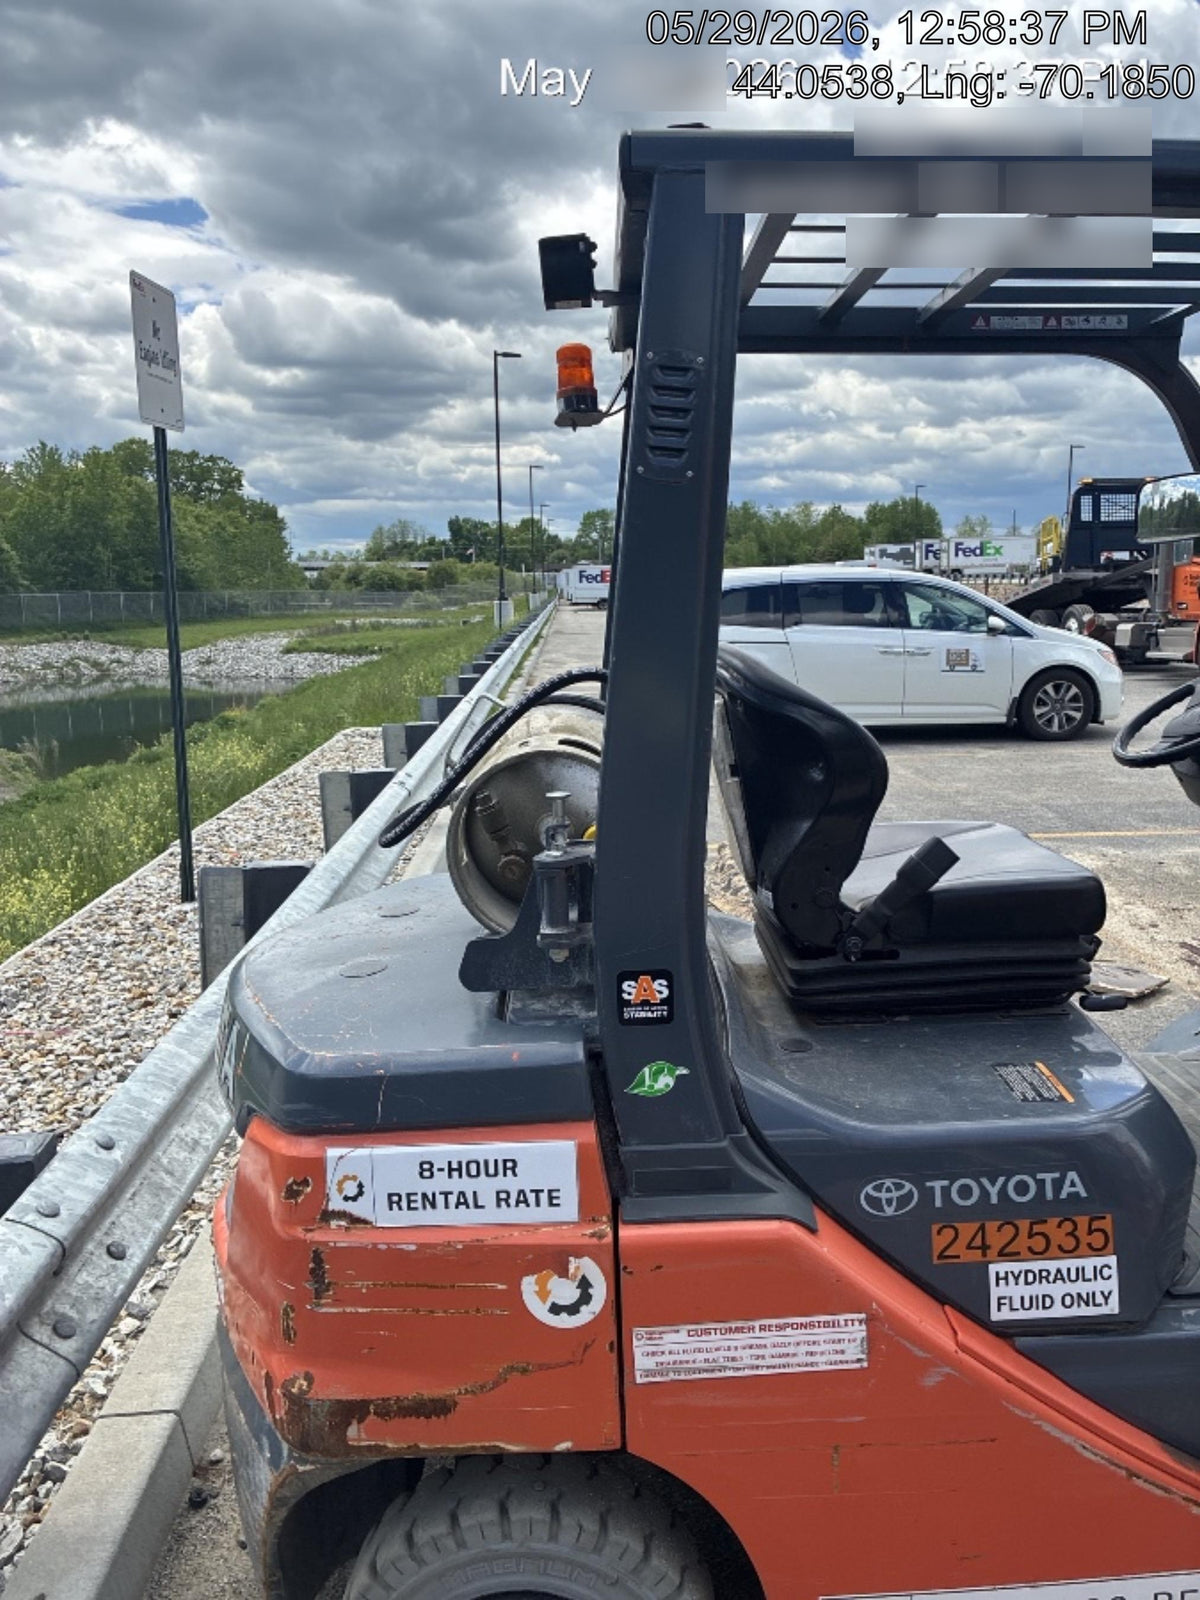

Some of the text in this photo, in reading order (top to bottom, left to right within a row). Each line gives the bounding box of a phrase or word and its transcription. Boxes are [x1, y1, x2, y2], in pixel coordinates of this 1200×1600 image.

[954, 540, 1004, 557] FedEx
[578, 569, 612, 584] FedE
[622, 976, 669, 1003] SAS
[418, 1158, 518, 1180] 8-HOUR
[387, 1188, 561, 1212] RENTAL RATE
[925, 1171, 1088, 1208] TOYOTA
[936, 1215, 1111, 1261] 242535
[995, 1263, 1113, 1288] HYDRAULIC
[996, 1289, 1114, 1313] FLUID ONLY
[687, 1324, 756, 1338] CUSTOMER
[758, 1317, 865, 1333] RESPONSIBILITY
[445, 1556, 599, 1589] MAGNUM
